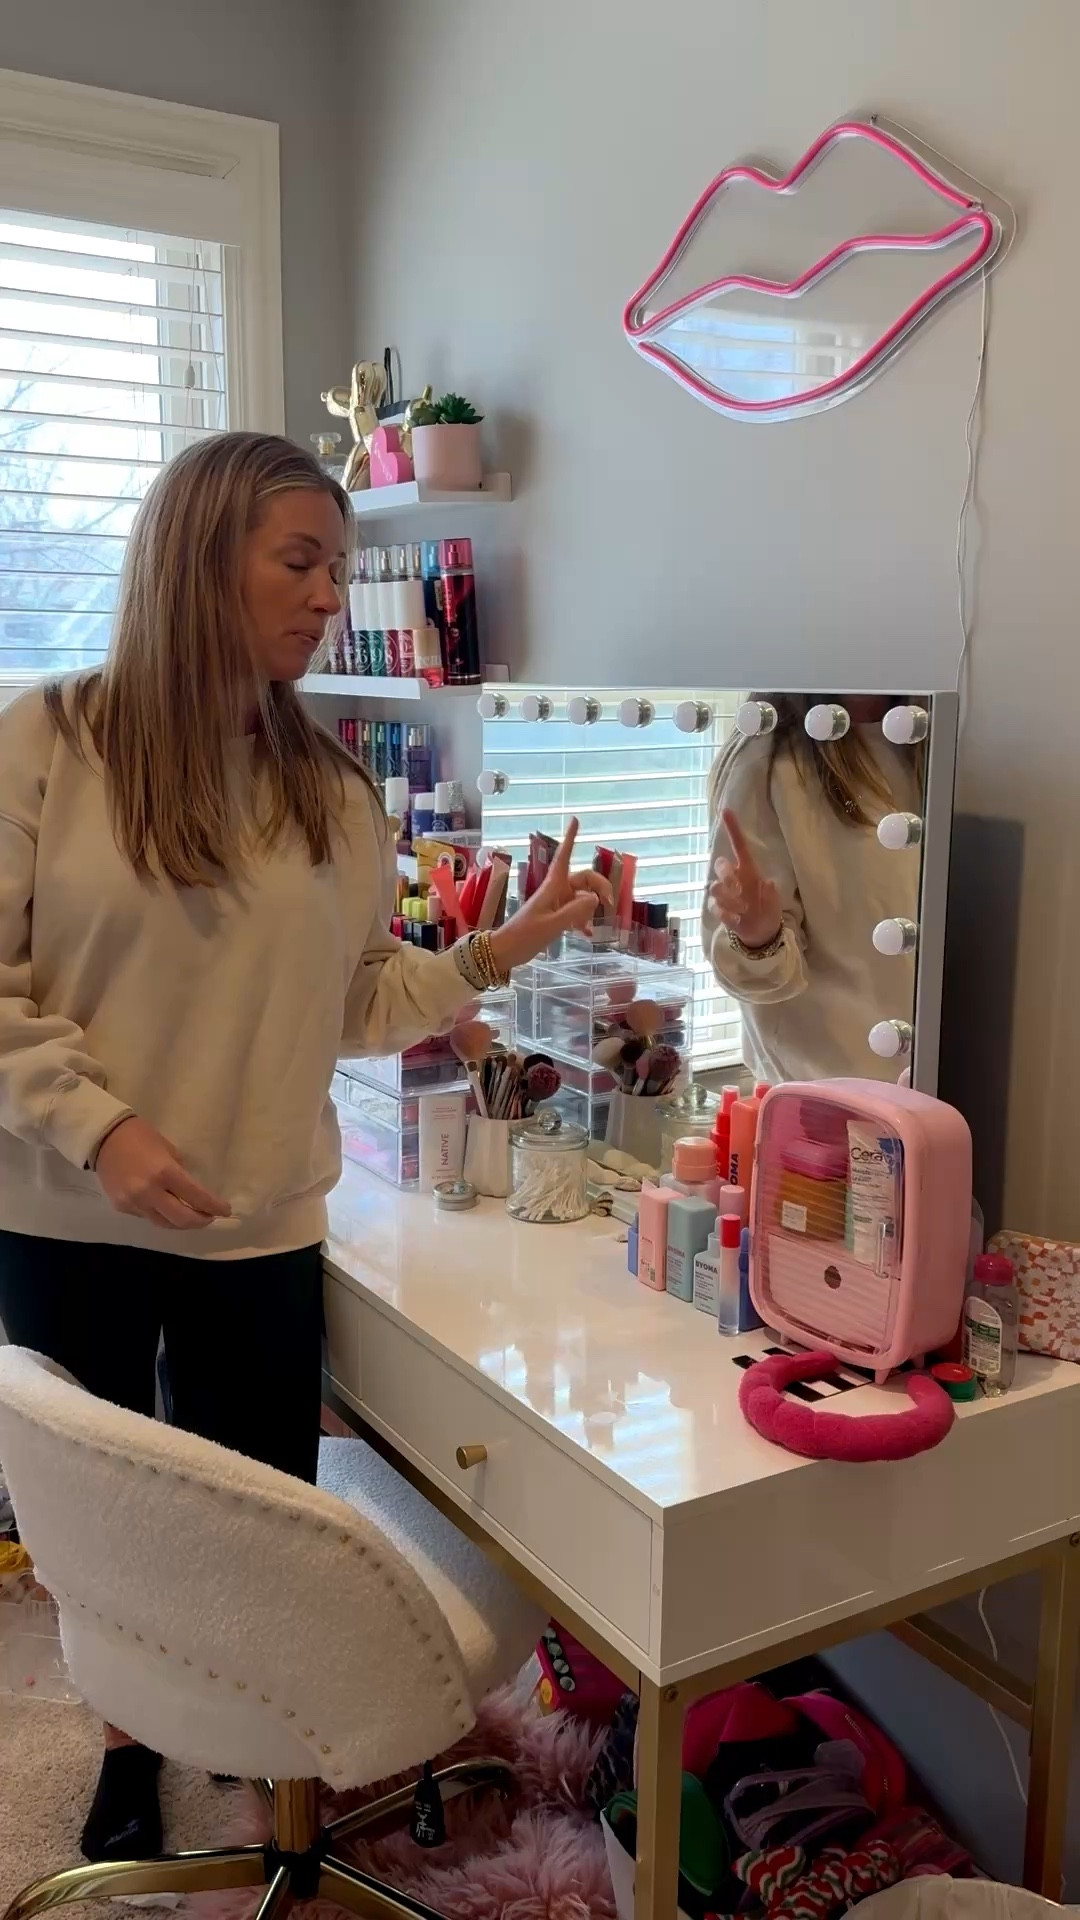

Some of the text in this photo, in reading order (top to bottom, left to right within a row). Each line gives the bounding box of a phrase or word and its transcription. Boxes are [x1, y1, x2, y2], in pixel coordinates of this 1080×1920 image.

[440, 1132, 450, 1166] NATIVE
[729, 1153, 739, 1186] OMA
[695, 1259, 719, 1275] BYOMA
